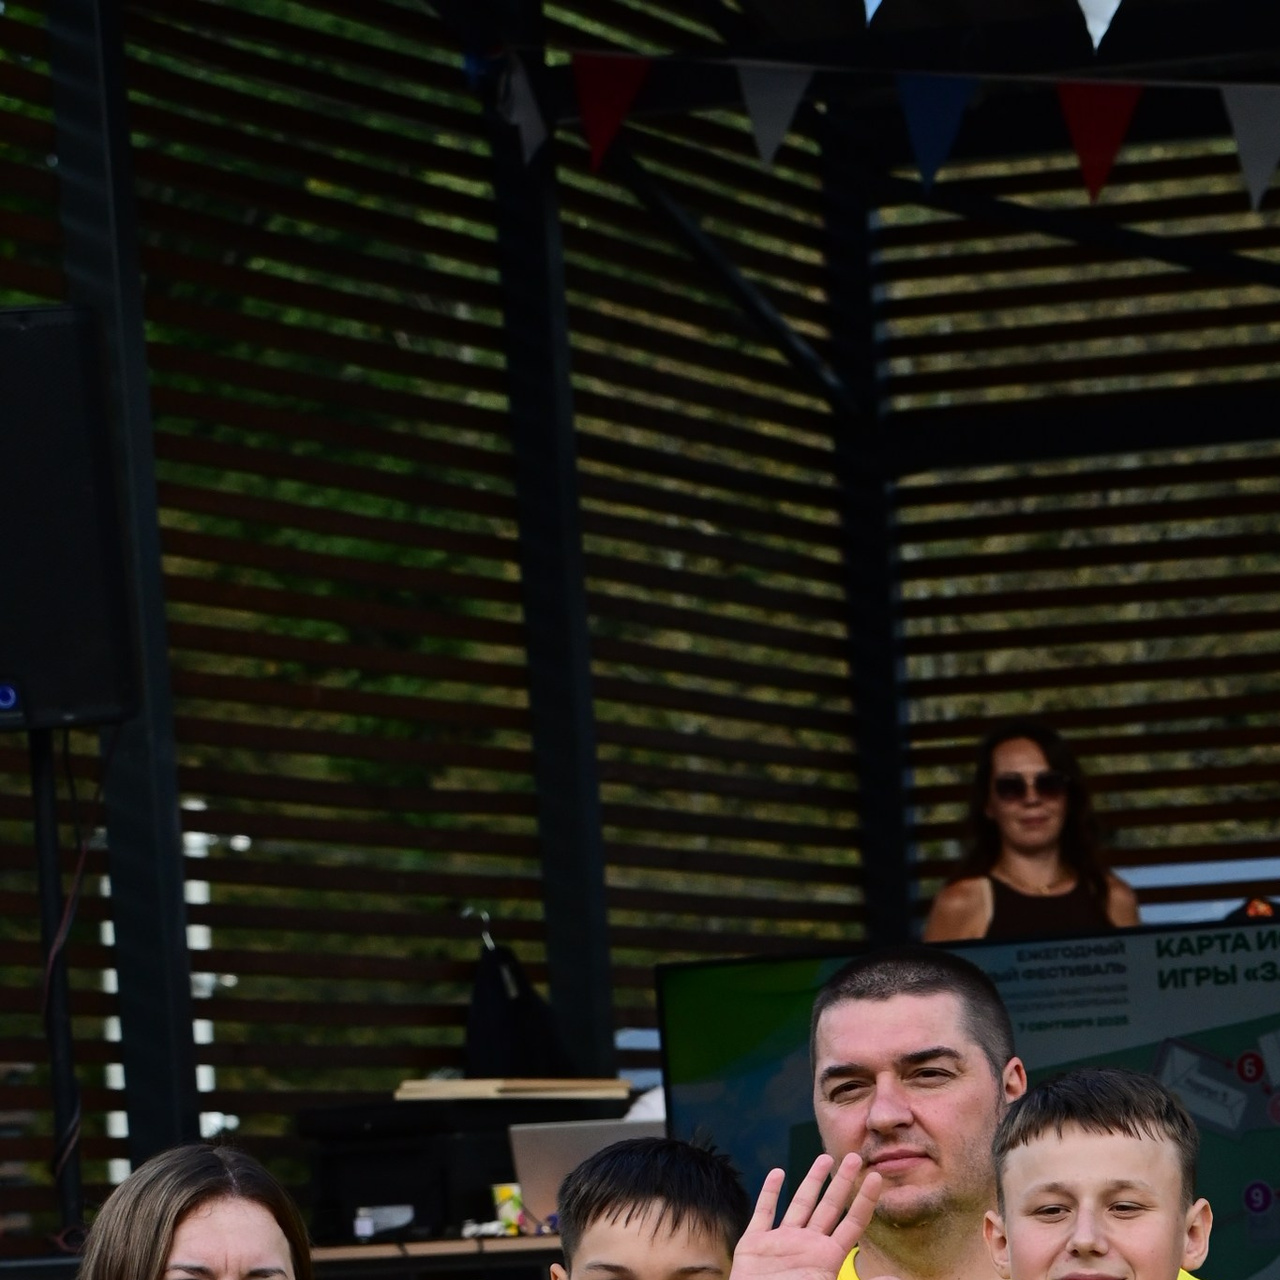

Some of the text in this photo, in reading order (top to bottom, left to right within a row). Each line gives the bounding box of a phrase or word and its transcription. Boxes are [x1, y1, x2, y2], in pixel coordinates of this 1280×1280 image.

[1016, 940, 1127, 963] ЕЖЕГОДНЫЙ
[1155, 931, 1251, 959] КАРТА
[1021, 962, 1128, 982] ФЕСТИВАЛЬ
[1157, 964, 1238, 990] ИГРЫ
[1244, 1058, 1256, 1078] 6
[1252, 1188, 1263, 1208] 9
